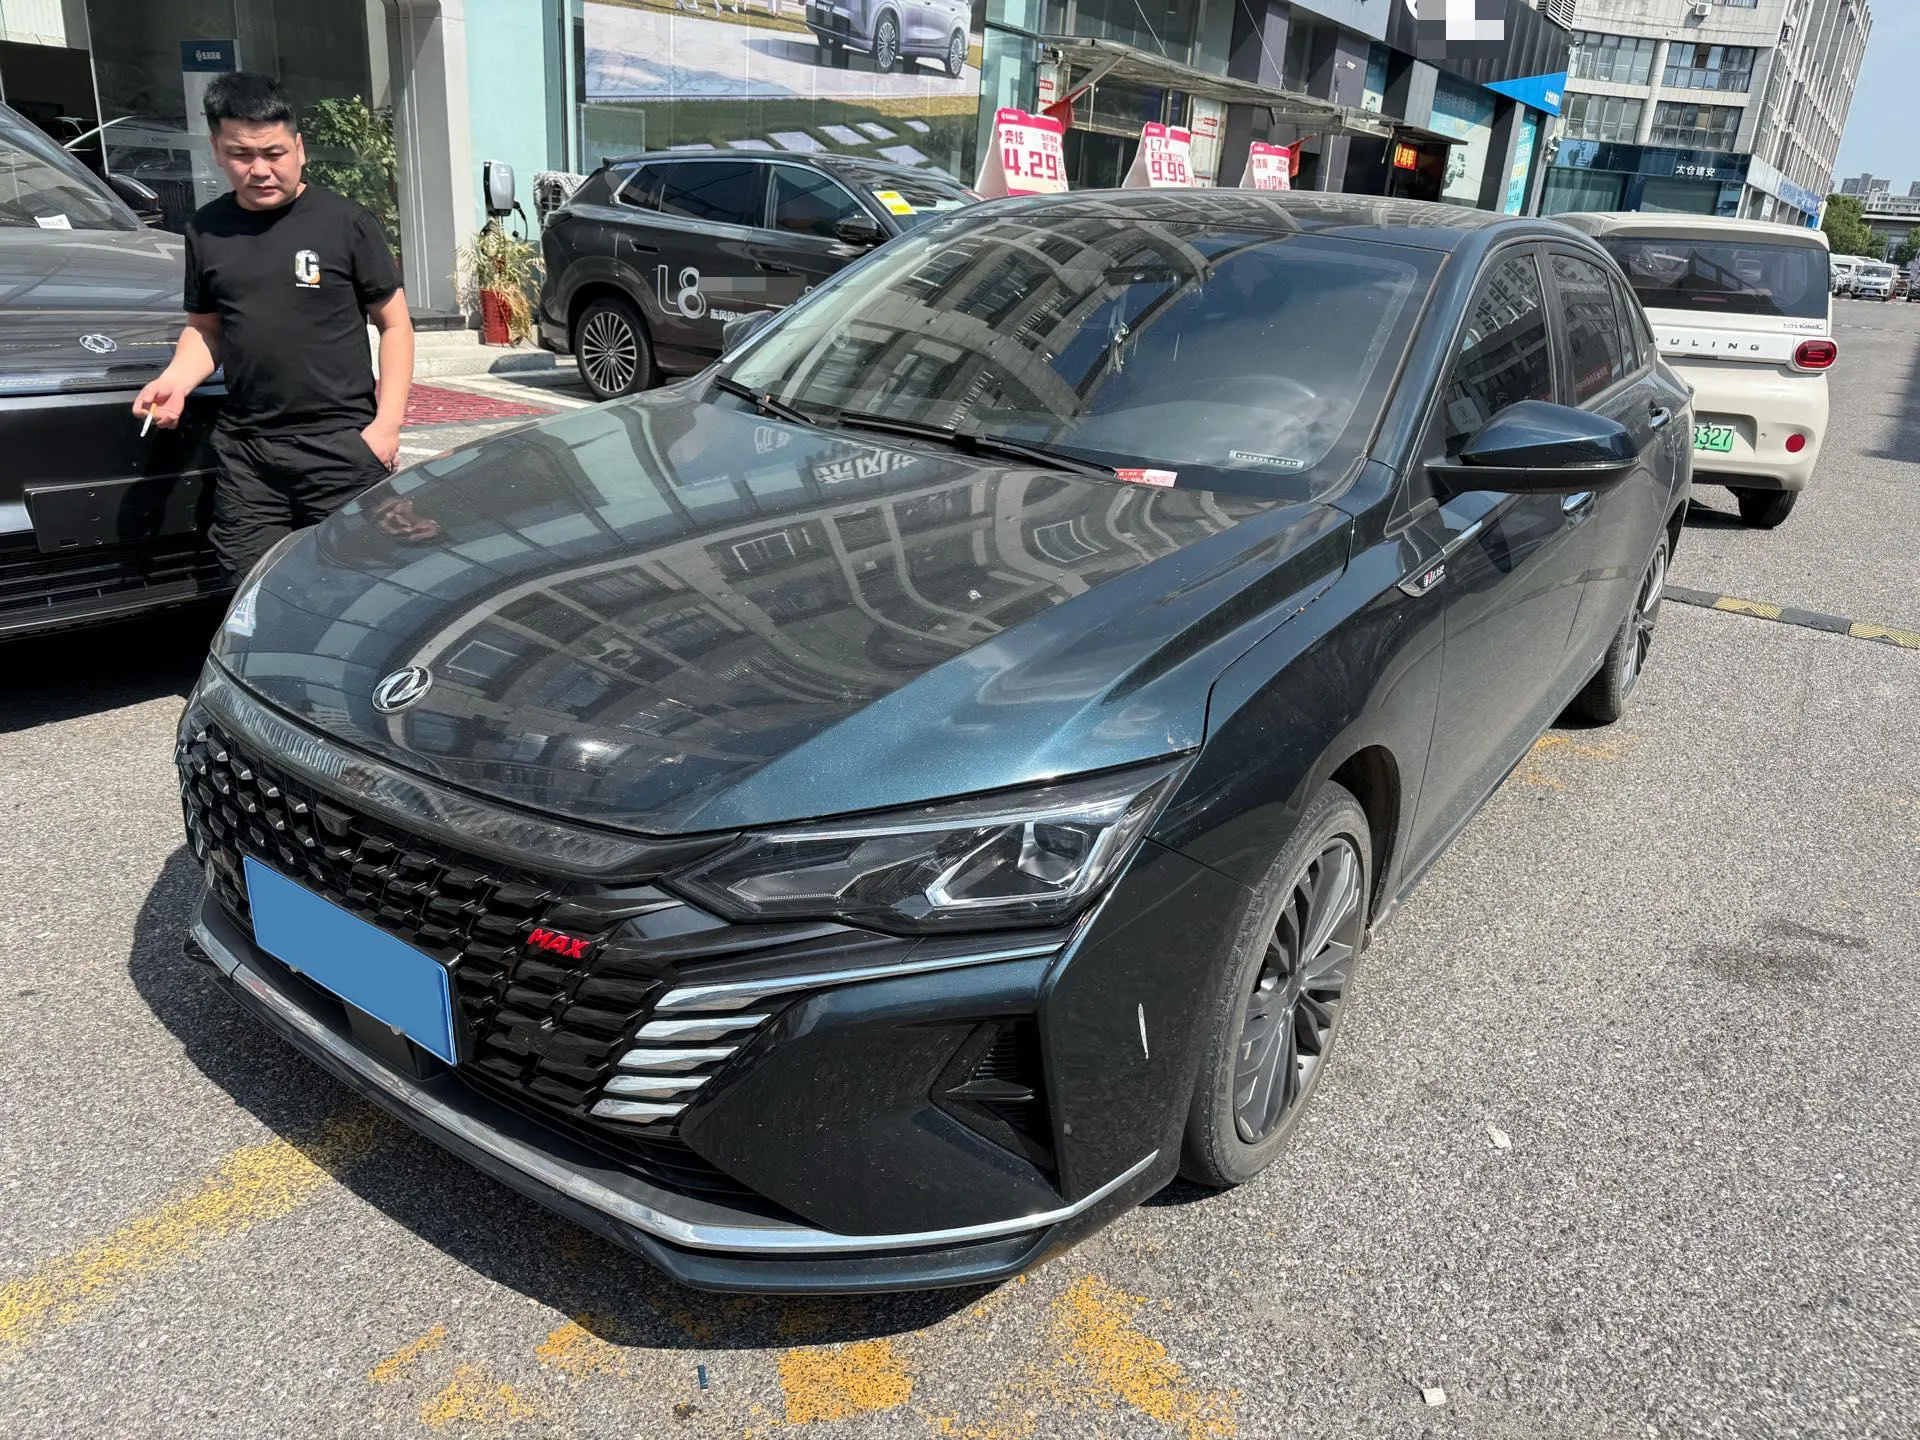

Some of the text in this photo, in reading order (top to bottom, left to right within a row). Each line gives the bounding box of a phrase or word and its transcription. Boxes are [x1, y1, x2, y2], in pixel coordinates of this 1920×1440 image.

[1004, 130, 1025, 145] 奕炫
[1004, 148, 1058, 181] 4.29
[1151, 160, 1187, 183] 9.99
[1675, 164, 1716, 177] 太仓建安
[657, 264, 707, 319] L8
[1655, 338, 1761, 351] ULING
[527, 927, 591, 959] MAX
